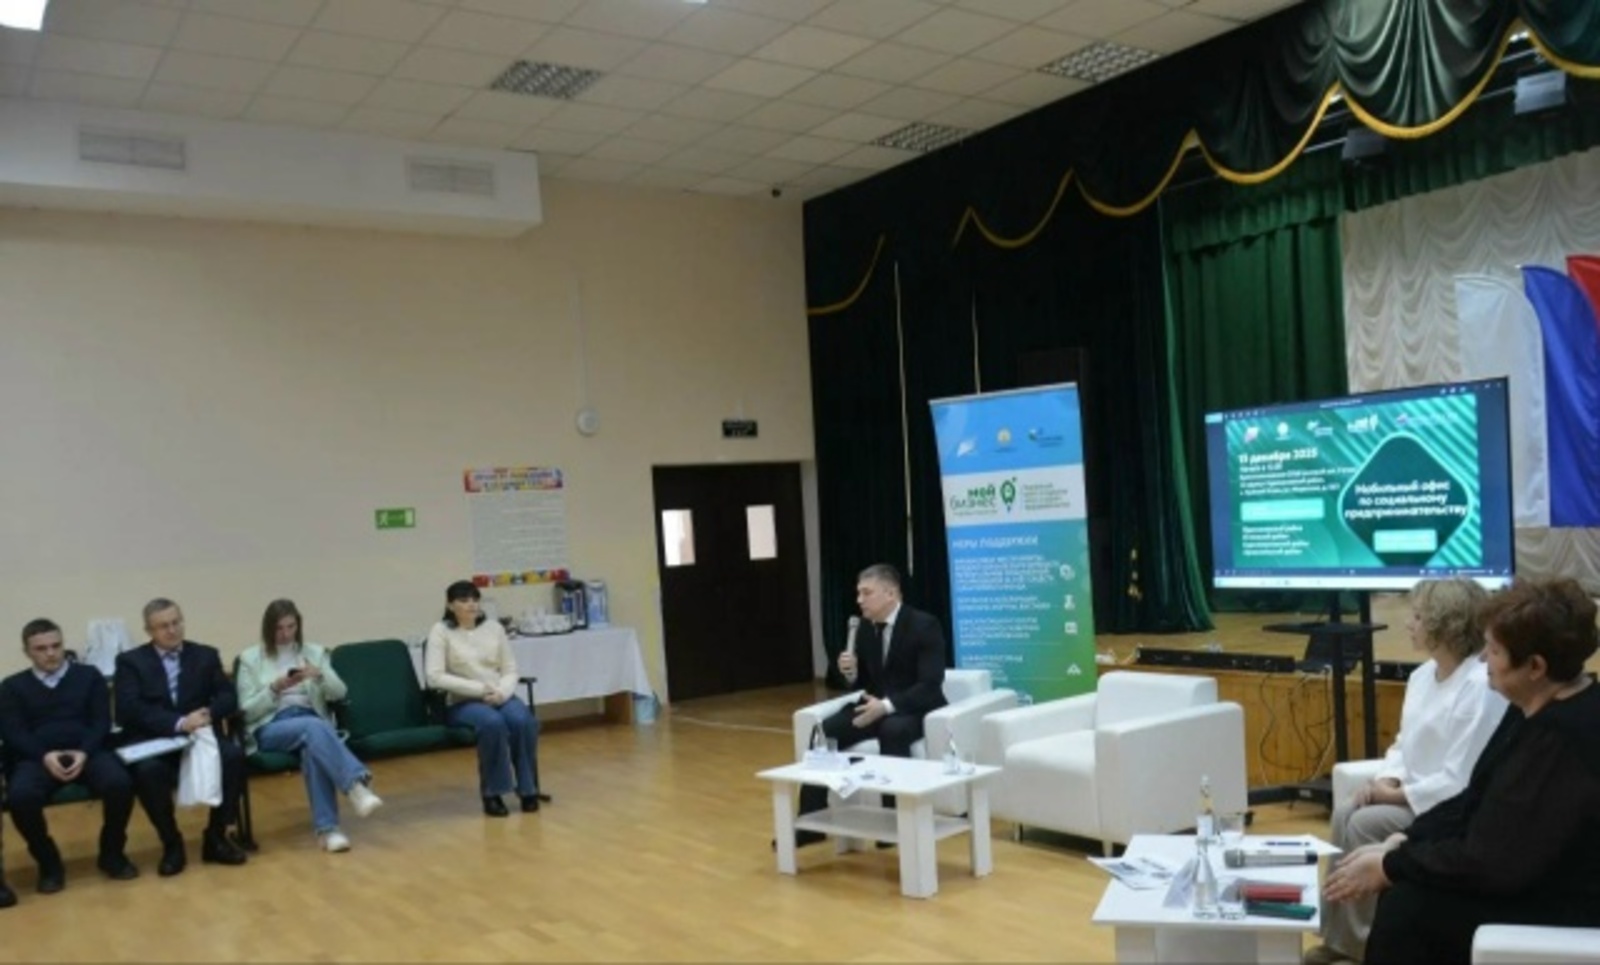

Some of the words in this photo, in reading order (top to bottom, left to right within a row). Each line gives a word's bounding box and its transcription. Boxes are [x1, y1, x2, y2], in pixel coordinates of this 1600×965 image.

[1355, 480, 1419, 495] Мобильный
[1421, 480, 1451, 492] офис
[1358, 497, 1373, 506] по
[1374, 494, 1448, 506] социальному
[1344, 505, 1467, 520] предпринимательству
